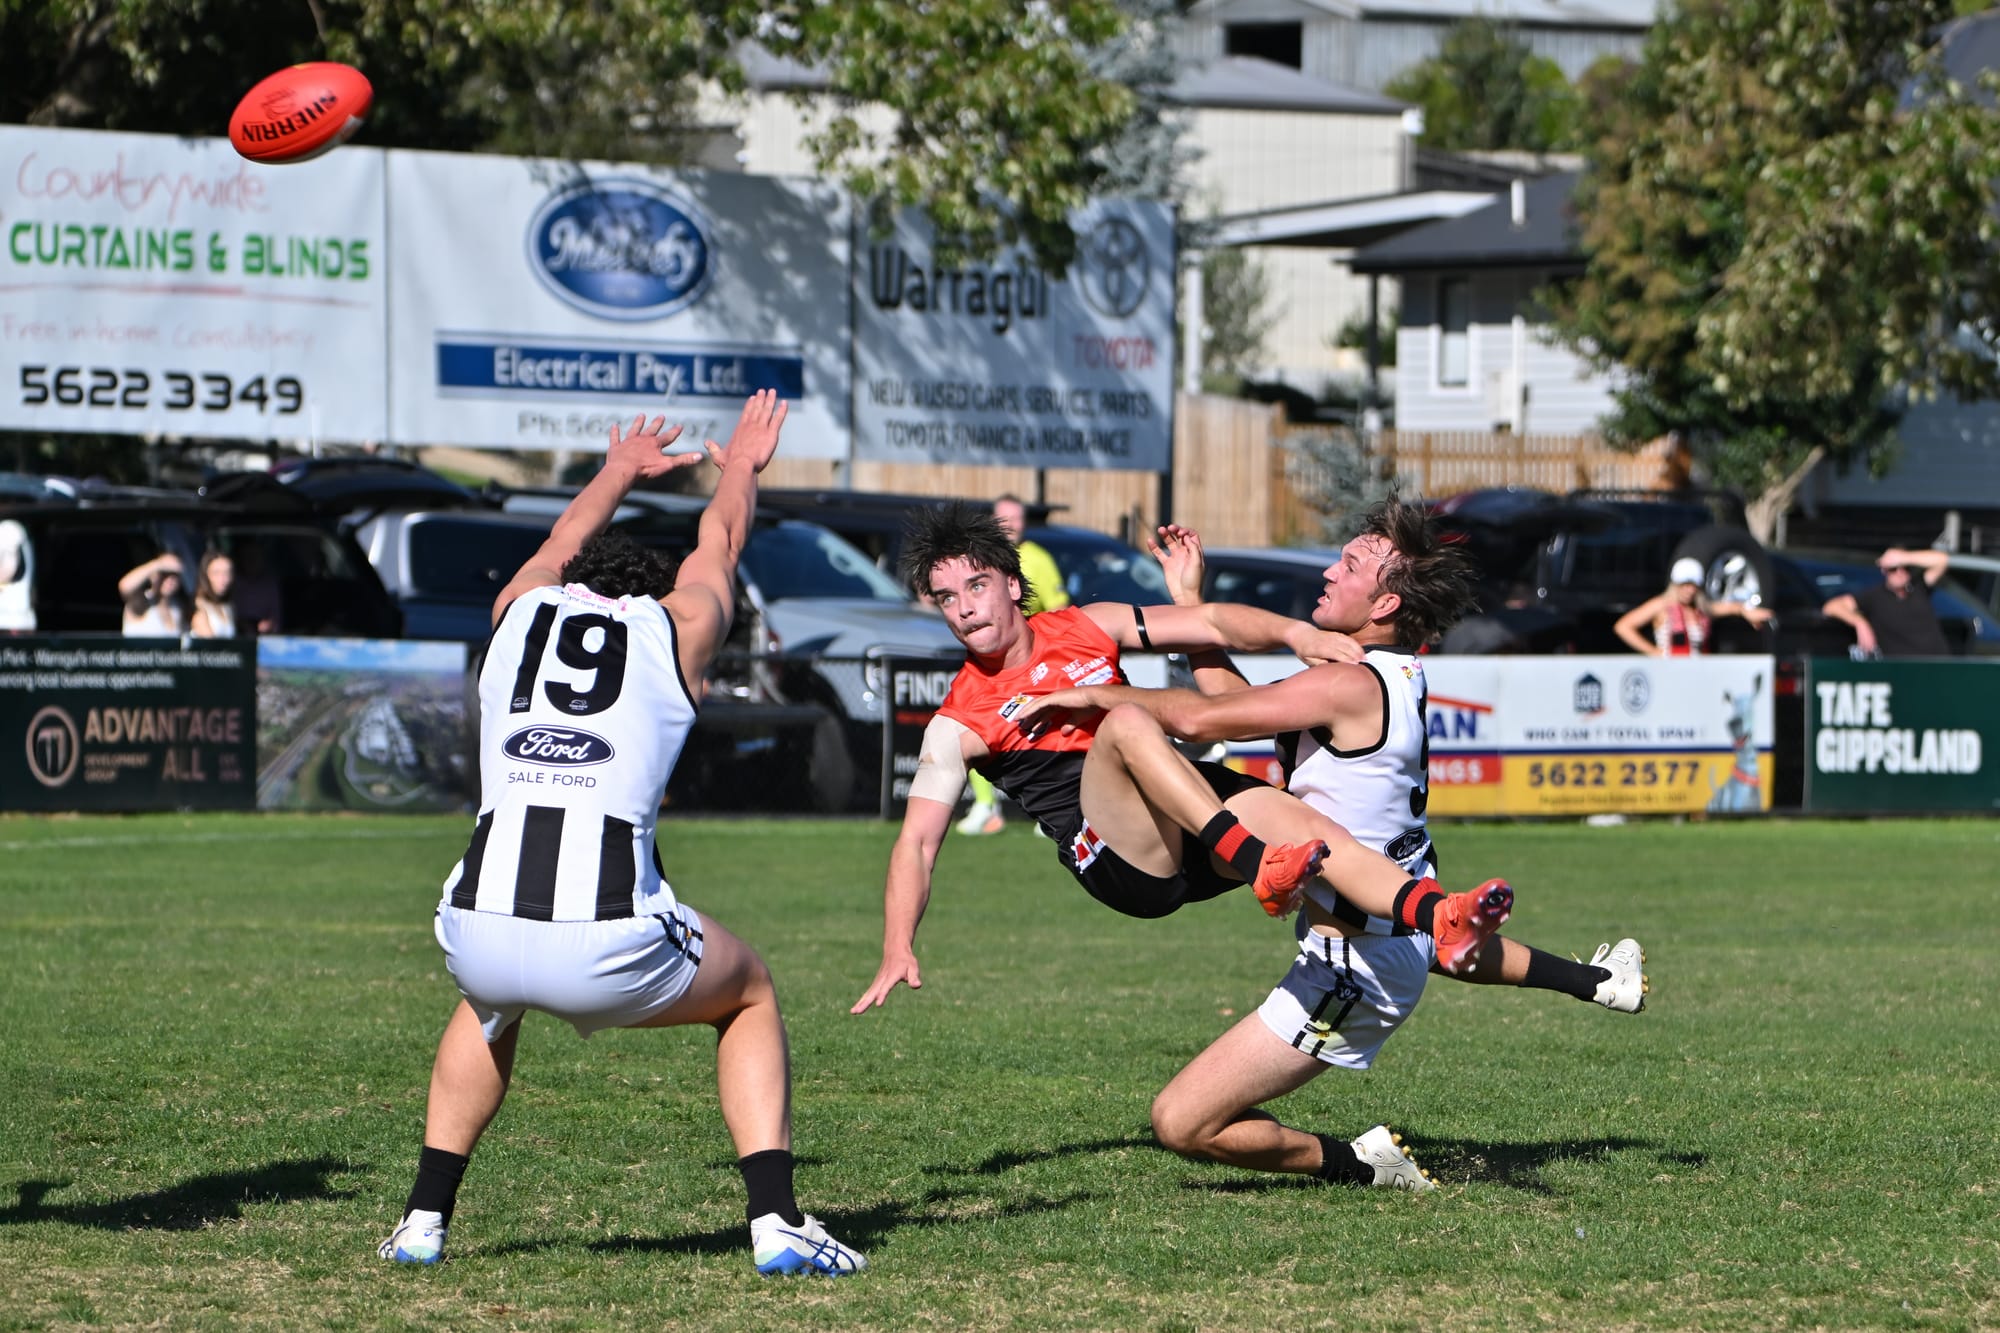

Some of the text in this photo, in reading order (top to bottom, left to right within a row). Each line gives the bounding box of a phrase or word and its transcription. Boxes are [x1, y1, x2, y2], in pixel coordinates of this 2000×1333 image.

[241, 89, 337, 142] SHERRIN
[9, 222, 370, 281] CURTAINS & BLINDS
[869, 245, 1048, 336] Warragul
[493, 346, 748, 403] Electrical Pty. Ltd.
[1072, 334, 1157, 371] TOYOTA
[21, 364, 303, 414] 5622 3349
[867, 379, 905, 409] NEW
[1101, 389, 1149, 421] PARTS
[1040, 425, 1132, 458] INSURANCE
[509, 602, 628, 716] 19
[84, 707, 240, 743] ADVANTAGE
[1815, 680, 1892, 727] TAFE
[518, 728, 592, 761] Ford
[1523, 727, 1556, 741] WHO
[1607, 727, 1651, 740] TOTAL
[1659, 727, 1695, 740] SPAN
[1815, 727, 1982, 774] GIPPSLAND
[507, 771, 597, 788] SALE FORD
[1529, 761, 1700, 788] 5622 2577
